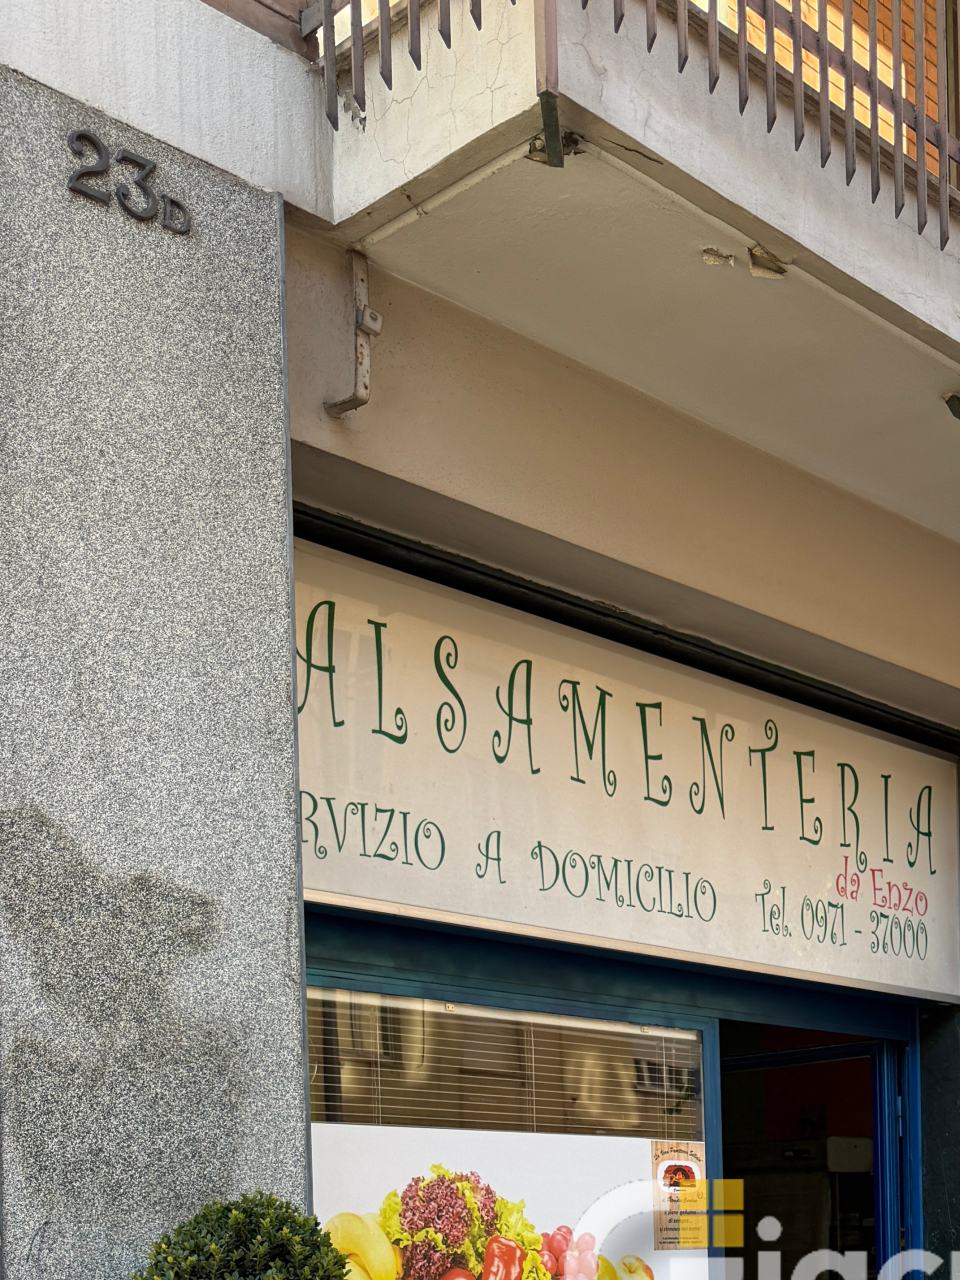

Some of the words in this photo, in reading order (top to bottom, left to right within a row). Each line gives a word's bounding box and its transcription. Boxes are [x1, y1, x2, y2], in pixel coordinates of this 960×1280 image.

[296, 600, 937, 874] ALSAMENTERIA
[300, 790, 445, 870] RVIZIO
[475, 830, 506, 884] A
[530, 840, 717, 922] DOMICILIO
[755, 879, 792, 937] Tel.
[800, 895, 847, 946] 0971
[869, 910, 928, 960] 37000
[836, 855, 860, 902] da
[870, 868, 928, 916] Enzo
